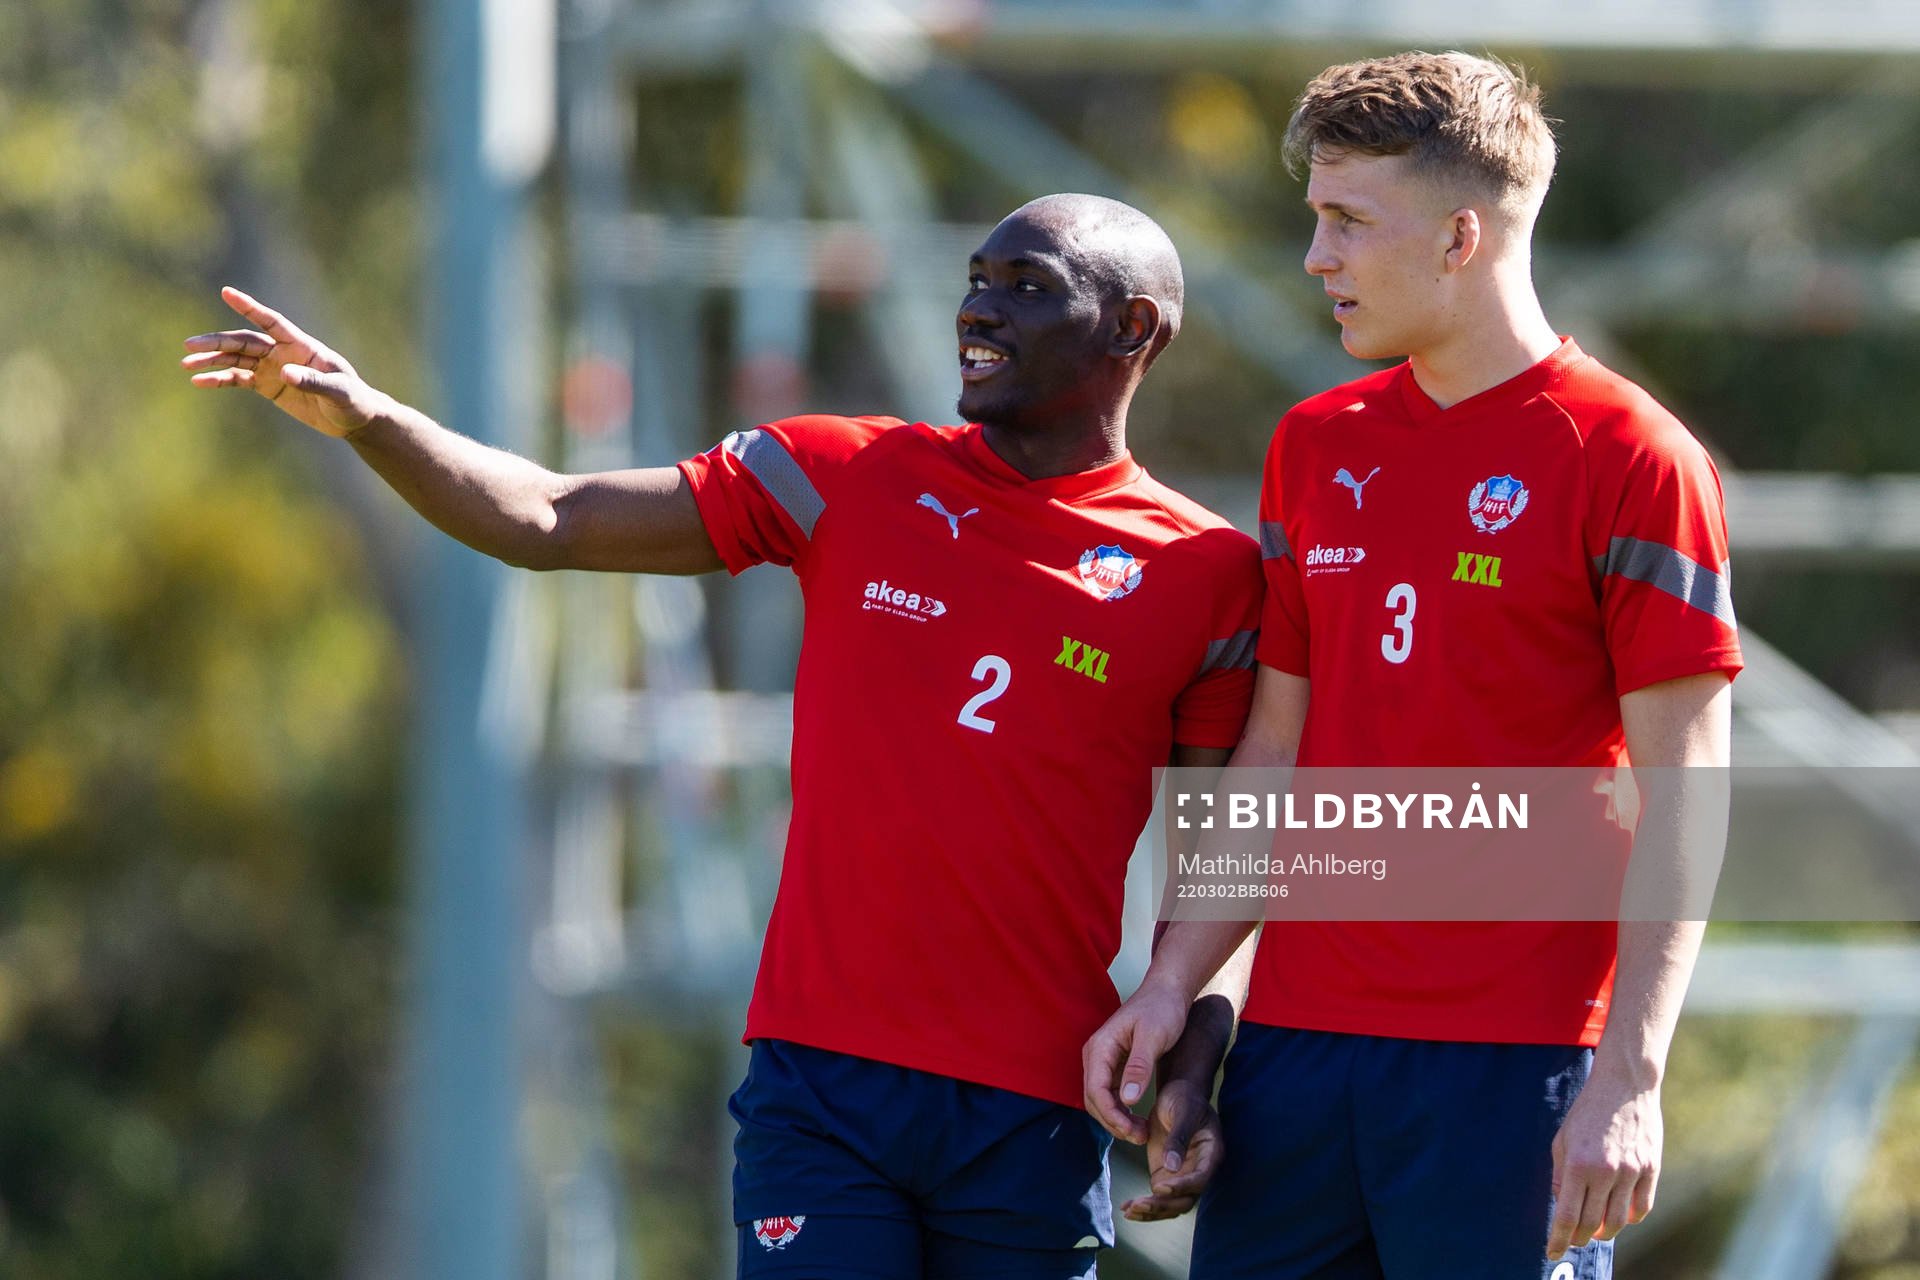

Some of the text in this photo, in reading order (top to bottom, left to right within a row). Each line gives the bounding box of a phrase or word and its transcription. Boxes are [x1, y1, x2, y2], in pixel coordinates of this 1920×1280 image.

[1306, 544, 1345, 566] akea
[1451, 551, 1503, 587] XXL
[864, 580, 921, 611] akea
[1381, 583, 1417, 664] 3
[1054, 636, 1110, 683] XXL
[957, 655, 1011, 733] 2
